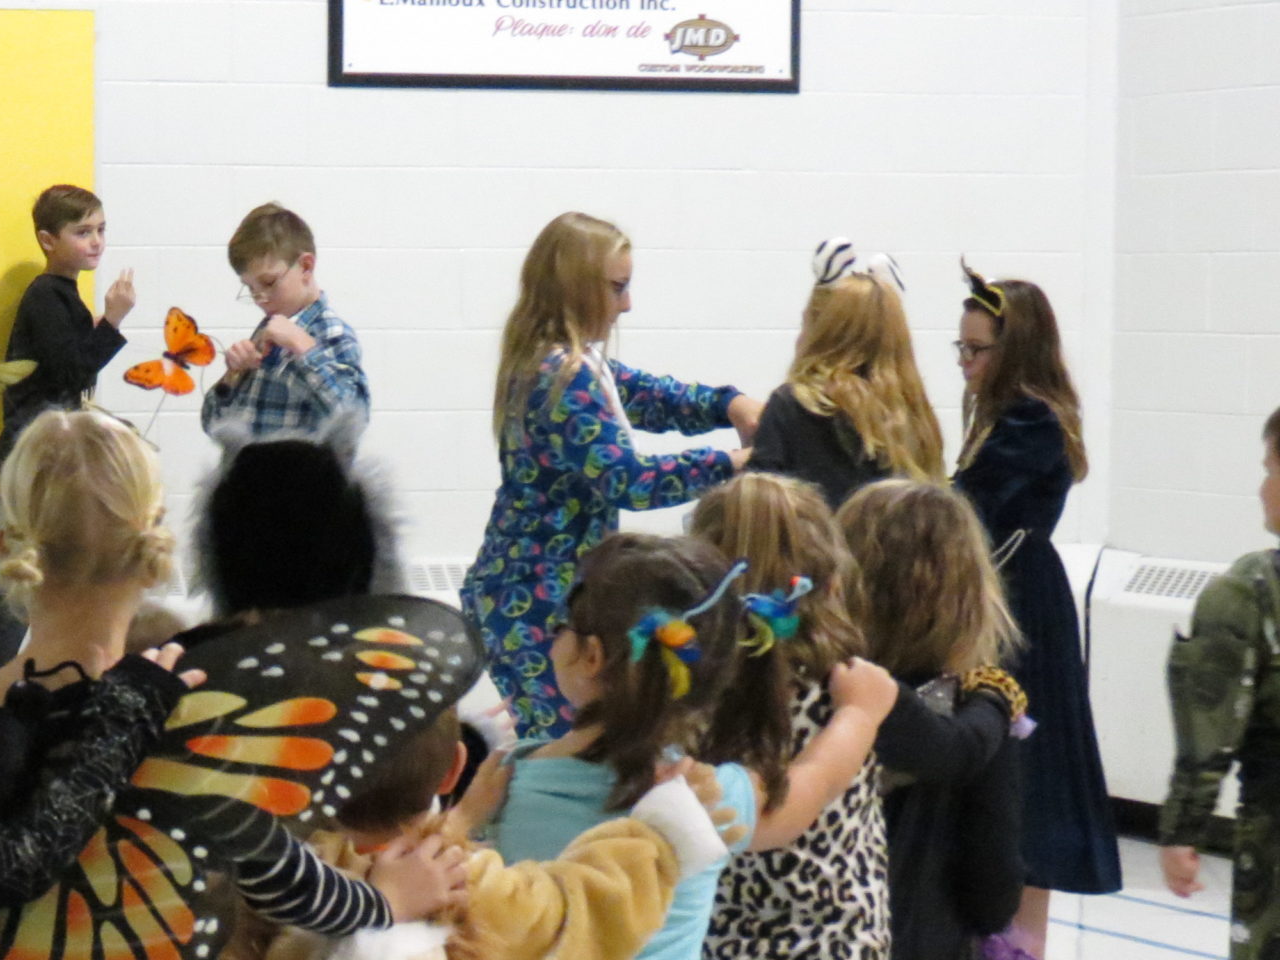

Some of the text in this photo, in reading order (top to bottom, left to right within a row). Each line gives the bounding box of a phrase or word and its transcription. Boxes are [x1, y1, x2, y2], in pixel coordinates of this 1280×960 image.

[496, 0, 630, 10] Construction
[640, 0, 676, 11] Inc.
[582, 19, 619, 38] don
[626, 20, 652, 39] de
[669, 26, 727, 54] JMD
